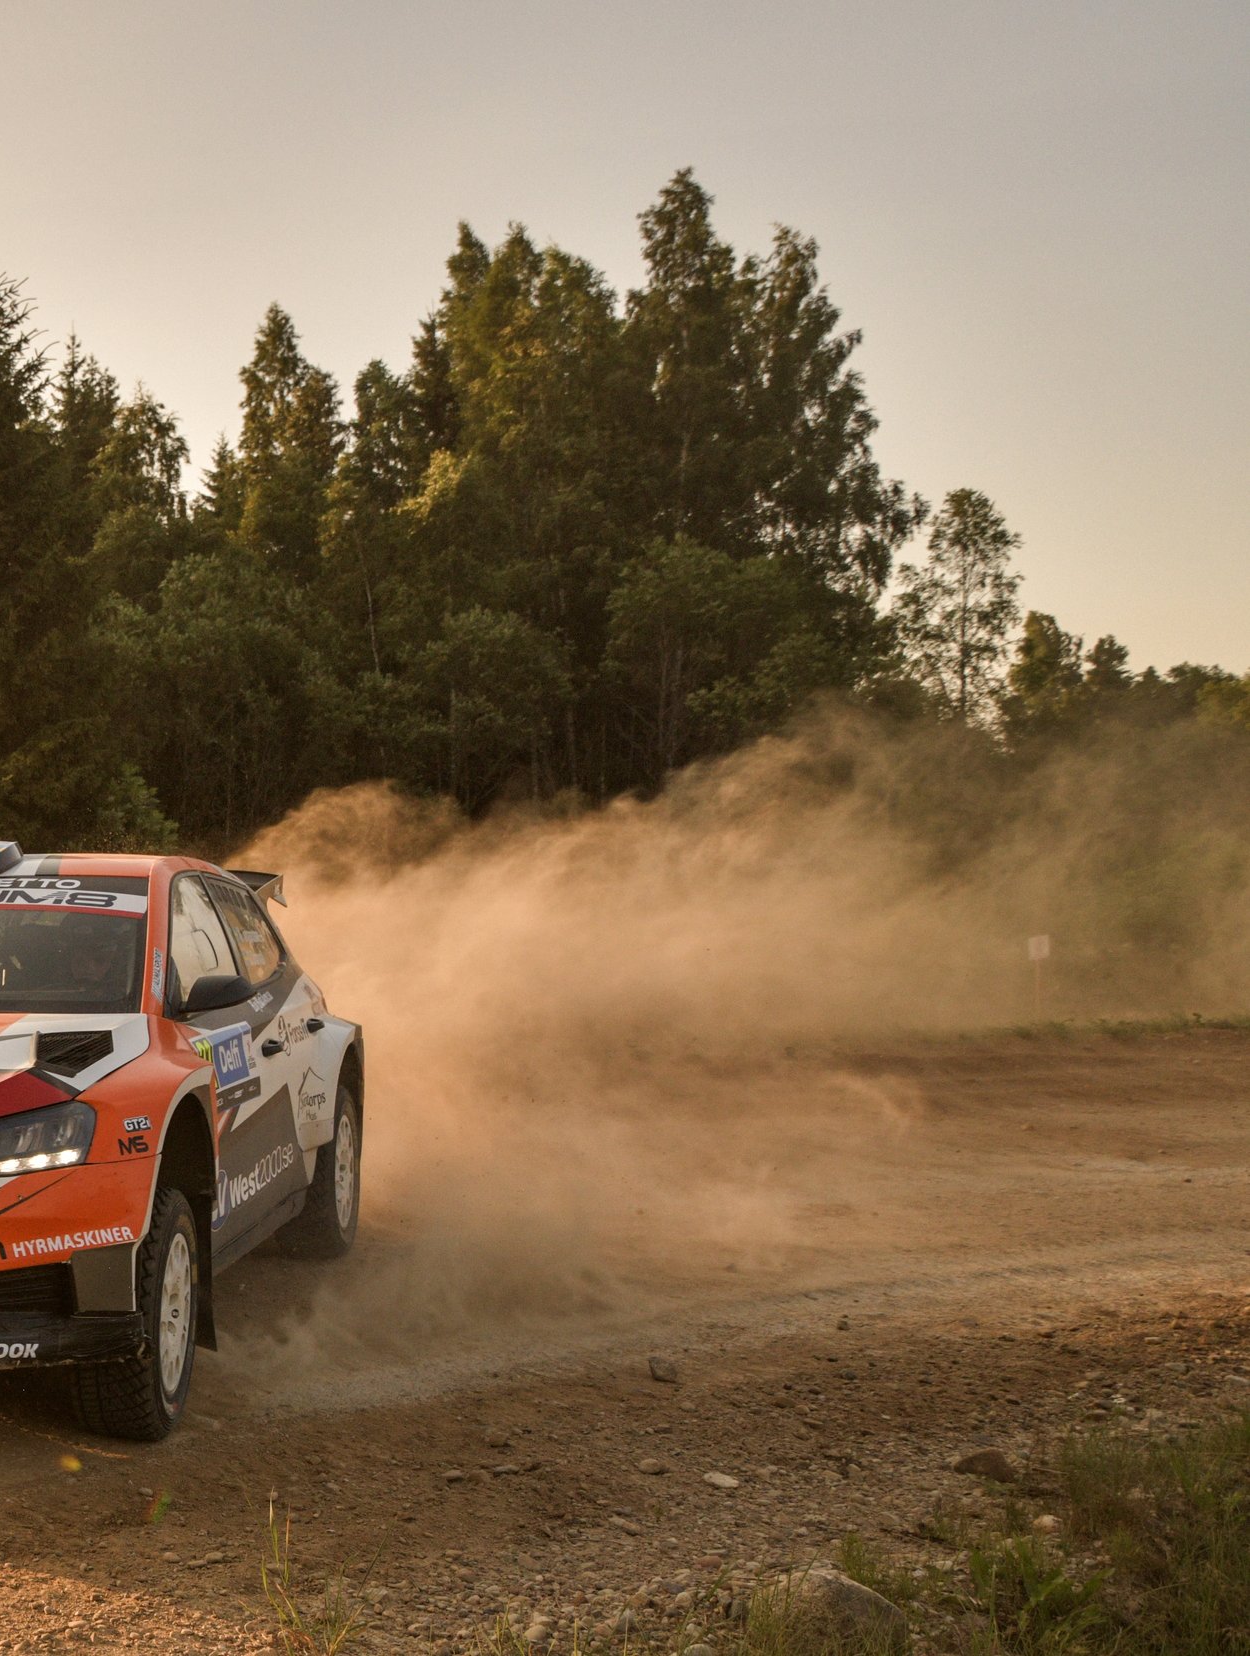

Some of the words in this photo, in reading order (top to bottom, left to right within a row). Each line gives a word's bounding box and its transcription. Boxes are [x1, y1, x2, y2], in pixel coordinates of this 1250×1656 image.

[218, 1038, 243, 1074] Delfi
[230, 1143, 294, 1209] West2000.se
[12, 1226, 134, 1258] HYRMASKINER
